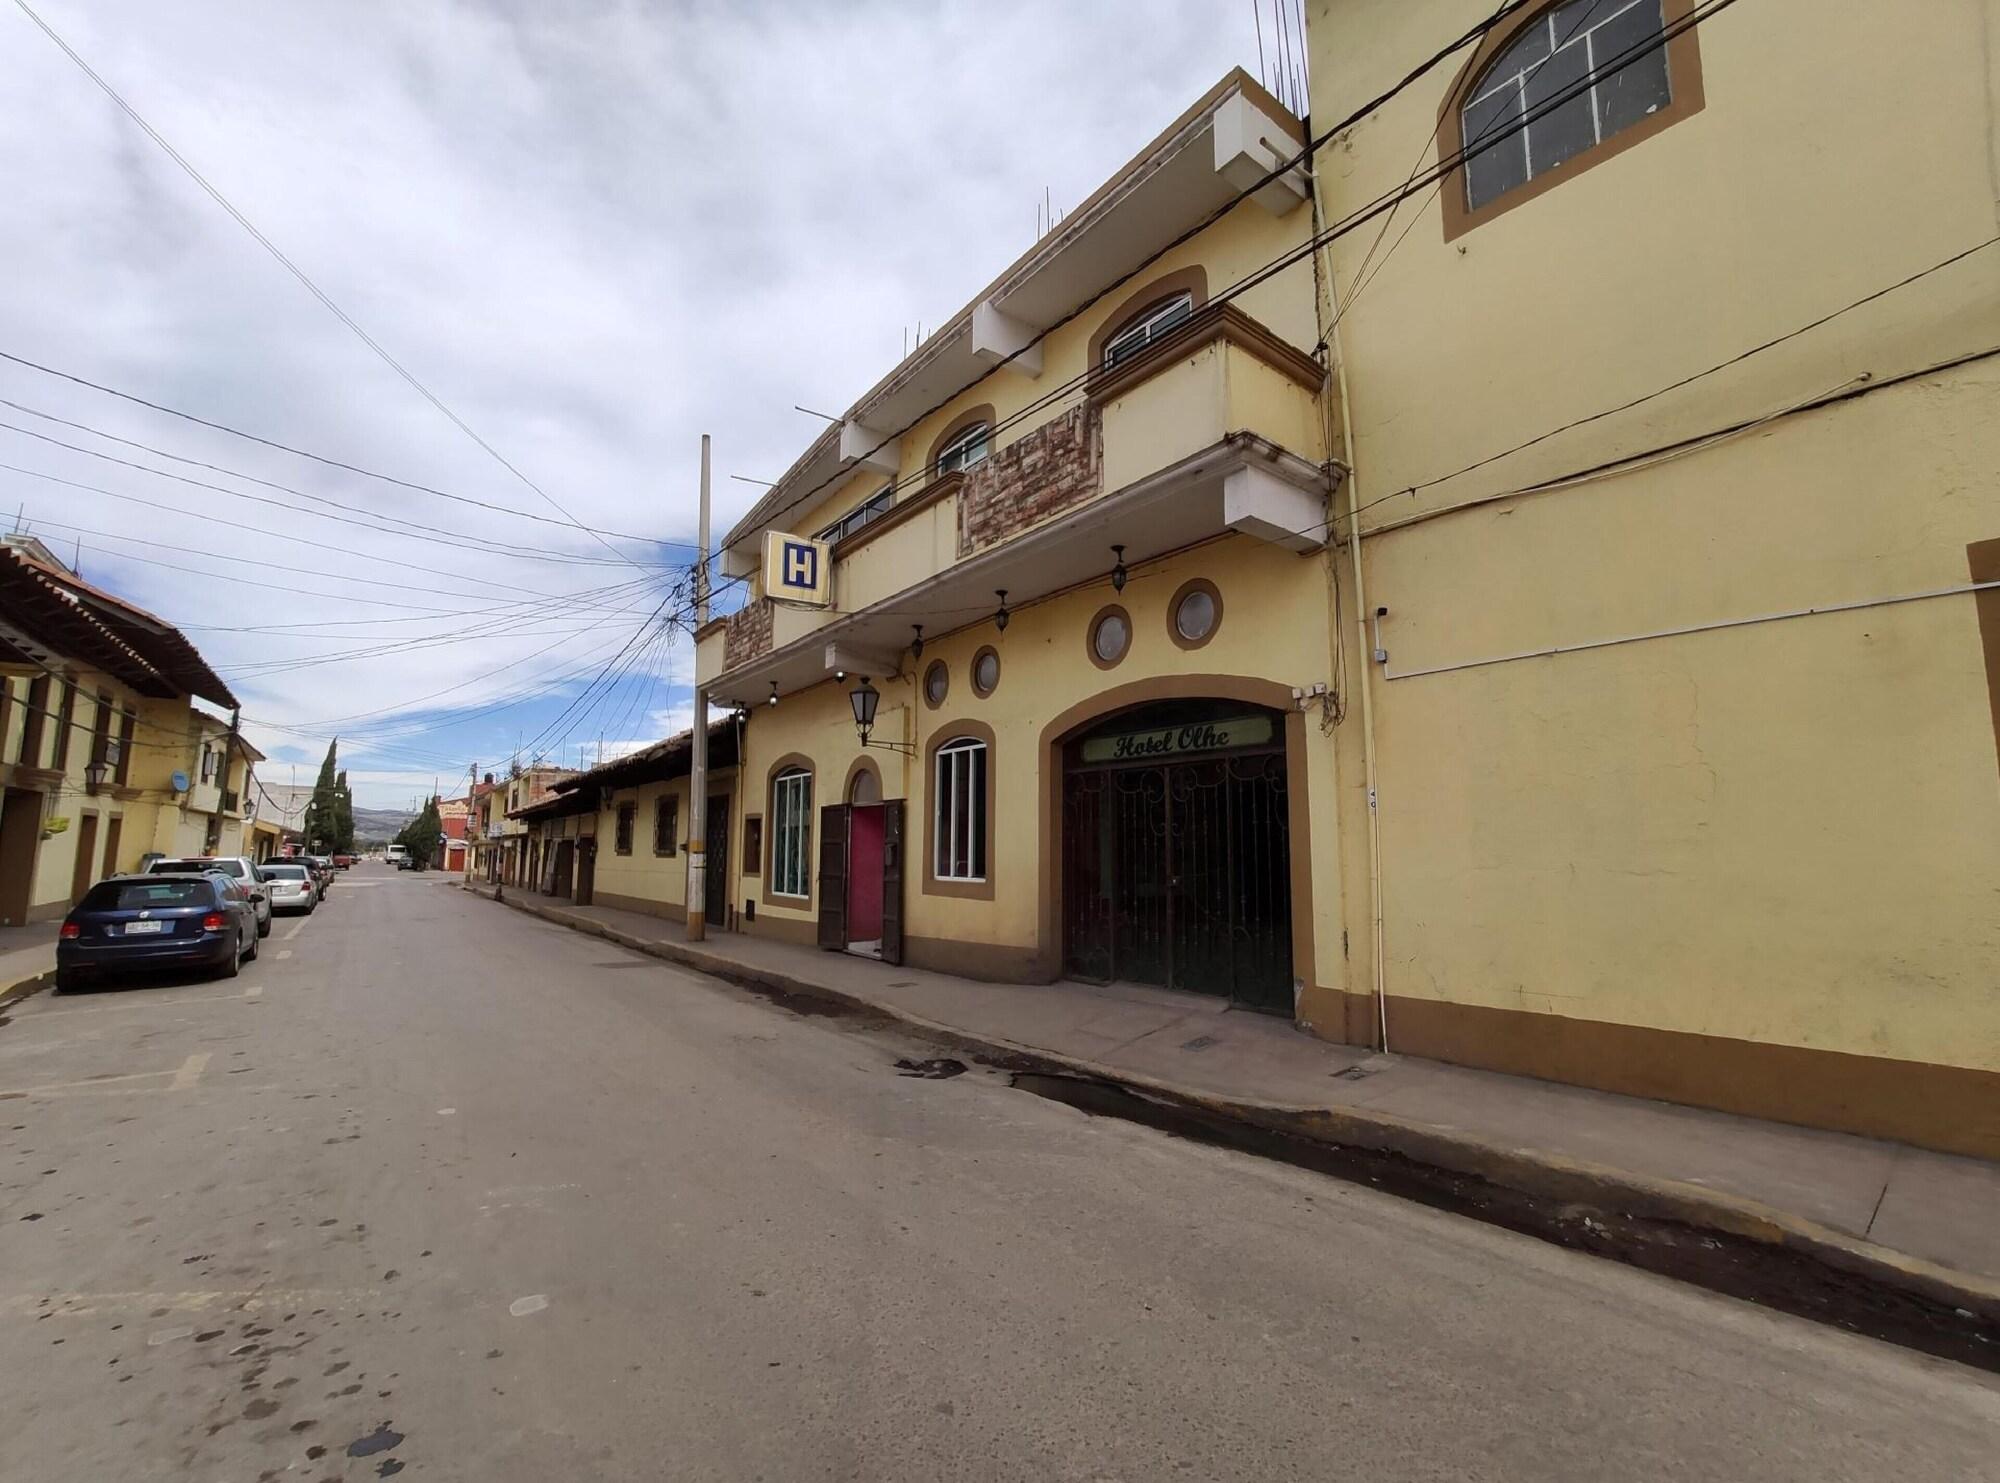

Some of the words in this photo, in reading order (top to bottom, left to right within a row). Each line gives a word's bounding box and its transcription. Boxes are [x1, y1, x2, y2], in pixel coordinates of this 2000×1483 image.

[789, 548, 812, 584] H
[1113, 732, 1173, 758] Hotel
[1178, 725, 1229, 750] Olhe
